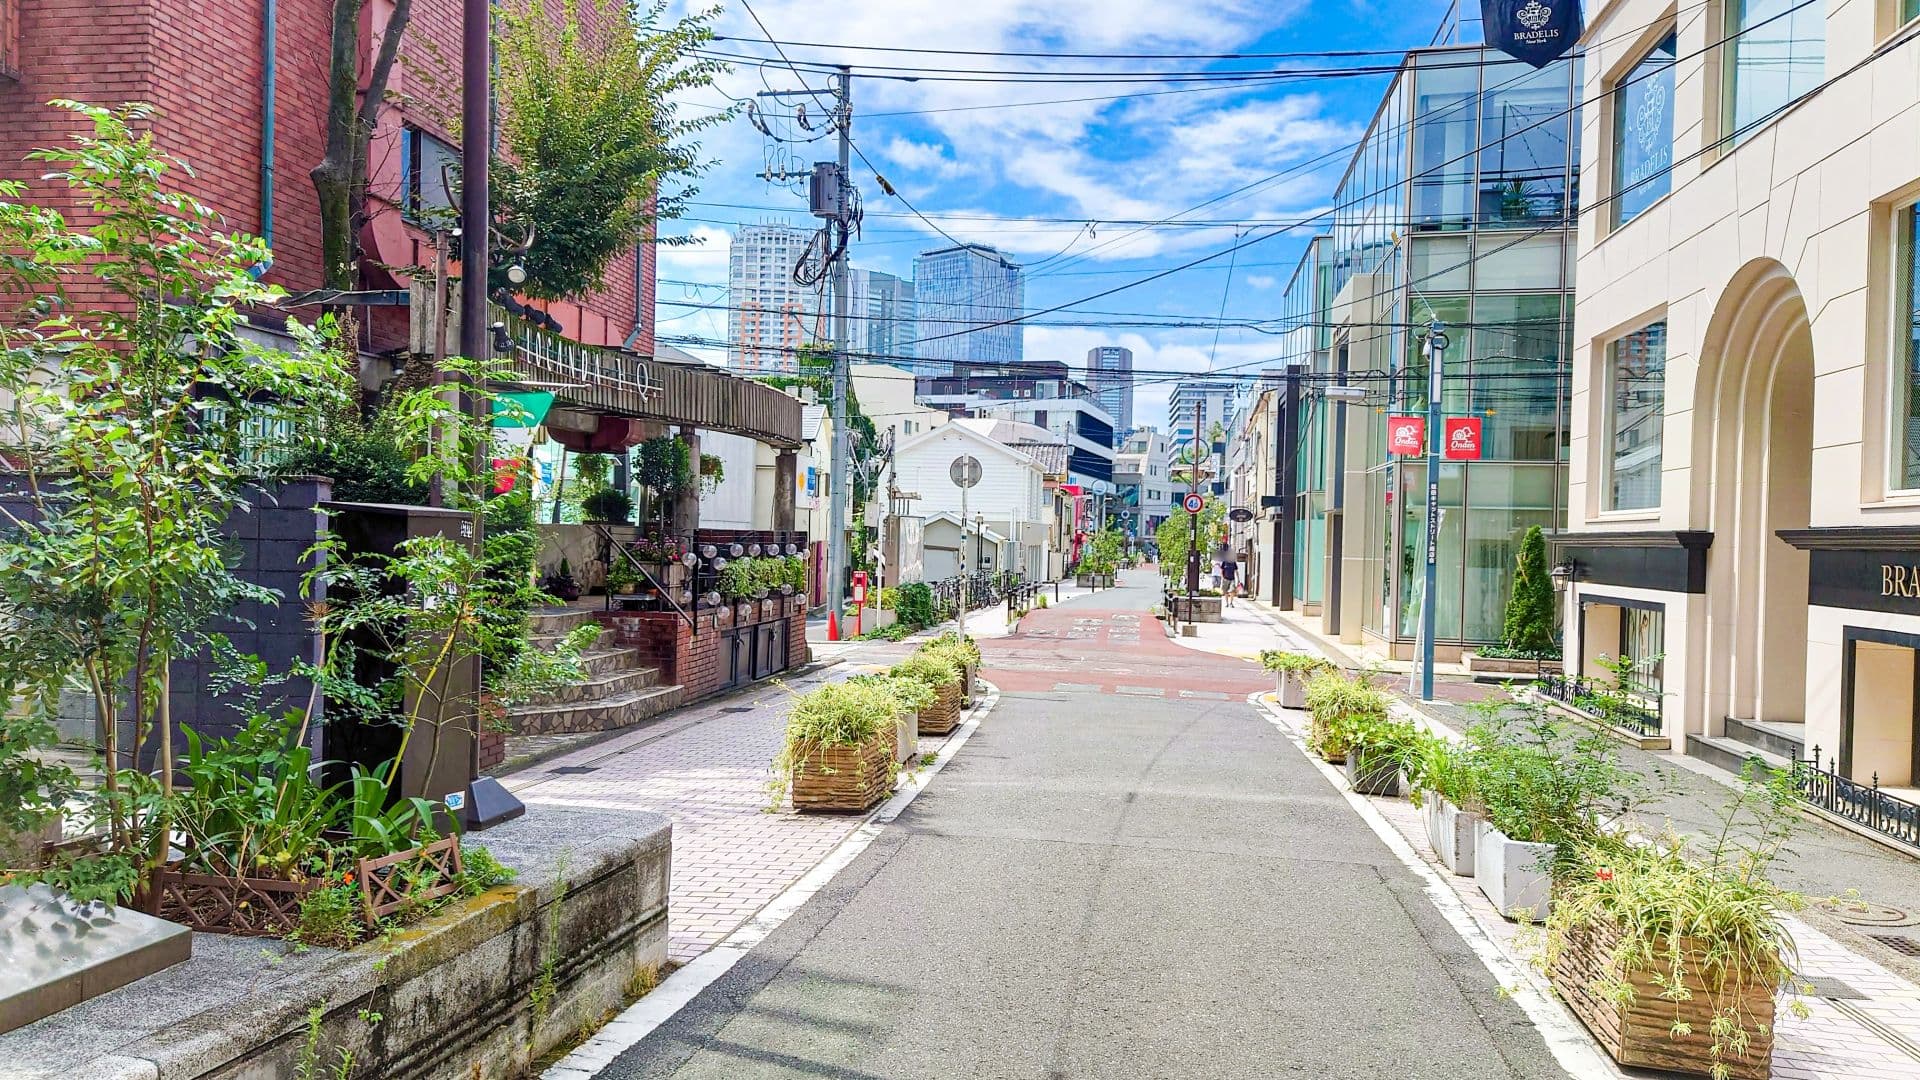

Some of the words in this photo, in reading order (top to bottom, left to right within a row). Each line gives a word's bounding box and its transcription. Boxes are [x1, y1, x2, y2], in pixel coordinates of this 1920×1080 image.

[1513, 29, 1559, 40] BRADELIS
[526, 327, 600, 385] LOCANDA
[1880, 565, 1920, 598] BRA
